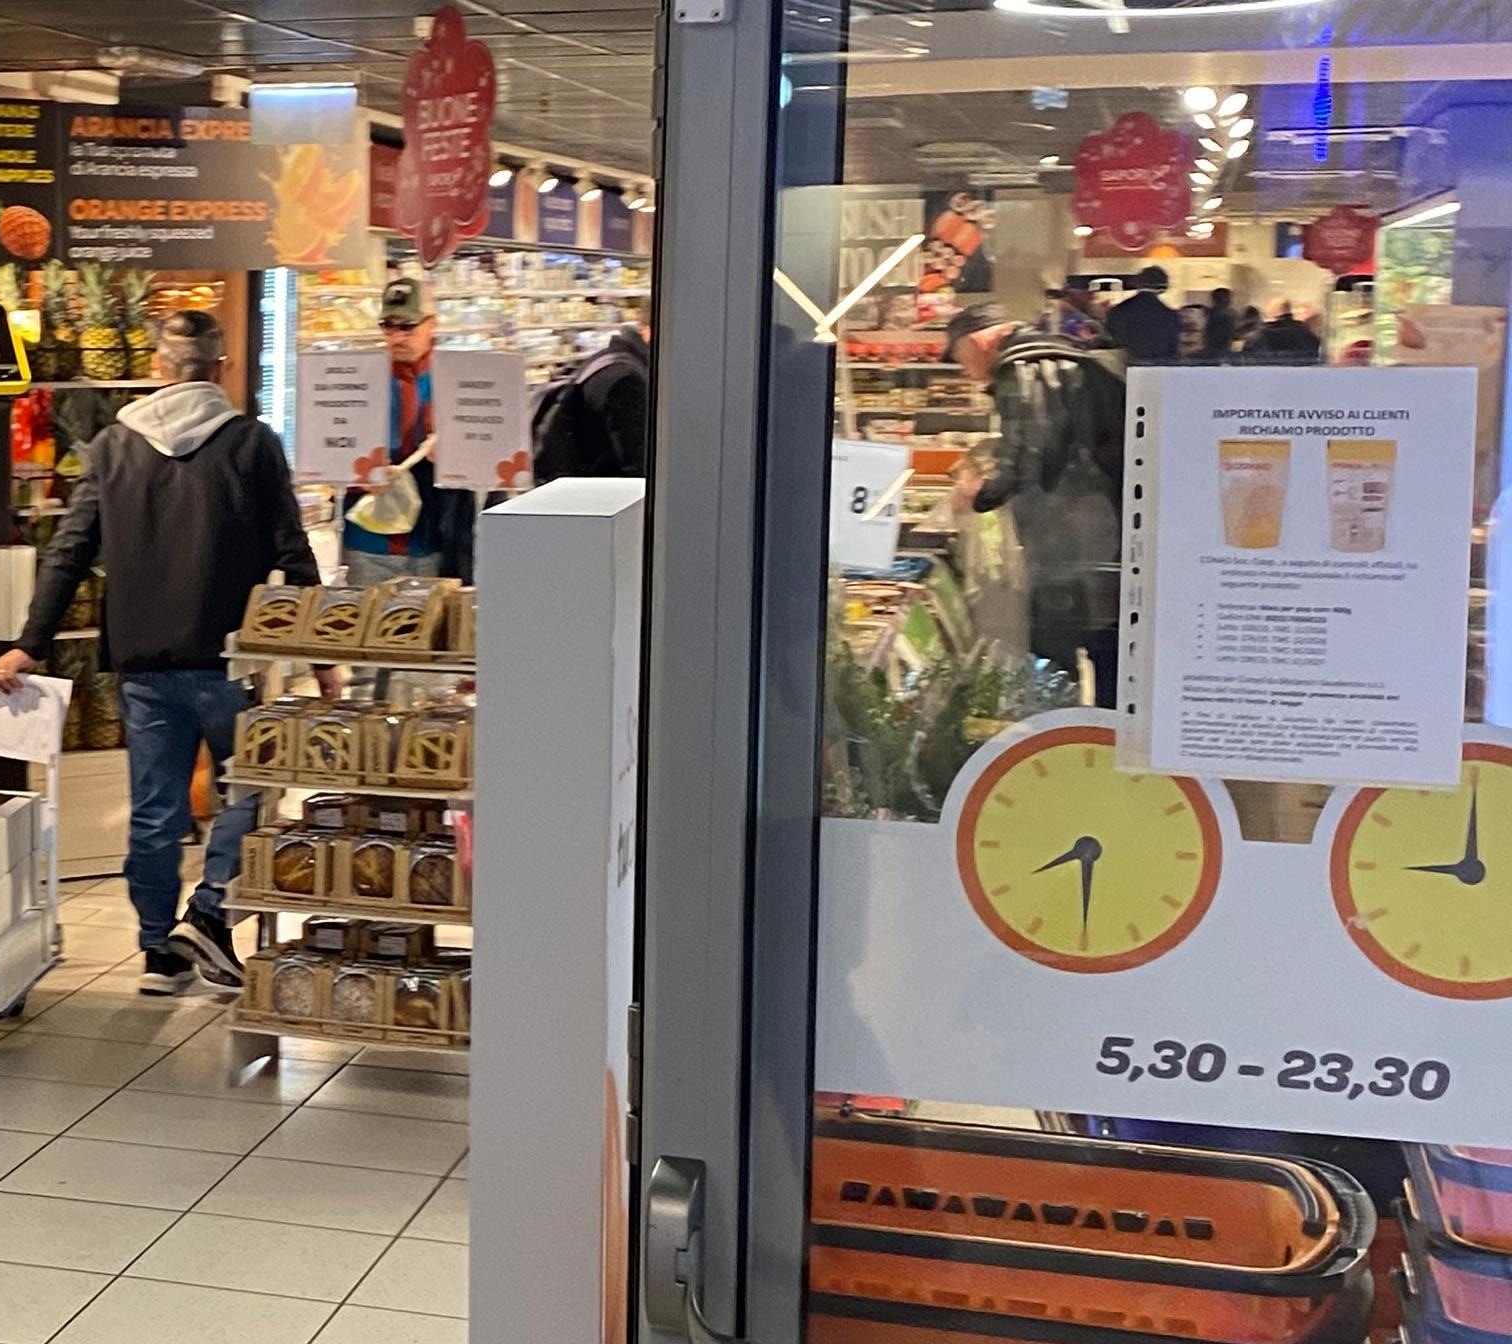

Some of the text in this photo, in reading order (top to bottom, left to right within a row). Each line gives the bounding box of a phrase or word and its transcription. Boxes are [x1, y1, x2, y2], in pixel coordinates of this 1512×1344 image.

[417, 91, 478, 130] BUONE
[70, 115, 251, 141] ARANCIA EXPRE
[422, 127, 473, 162] FESTE
[68, 199, 267, 221] ORANGE EXPRESS
[1213, 409, 1410, 421] IMPORTANTE AVVISO AI CLIENTI
[1240, 425, 1376, 437] RICHIAMO PRODOTTO
[1096, 1036, 1227, 1083] 5,30
[1276, 1049, 1451, 1101] 23,30
